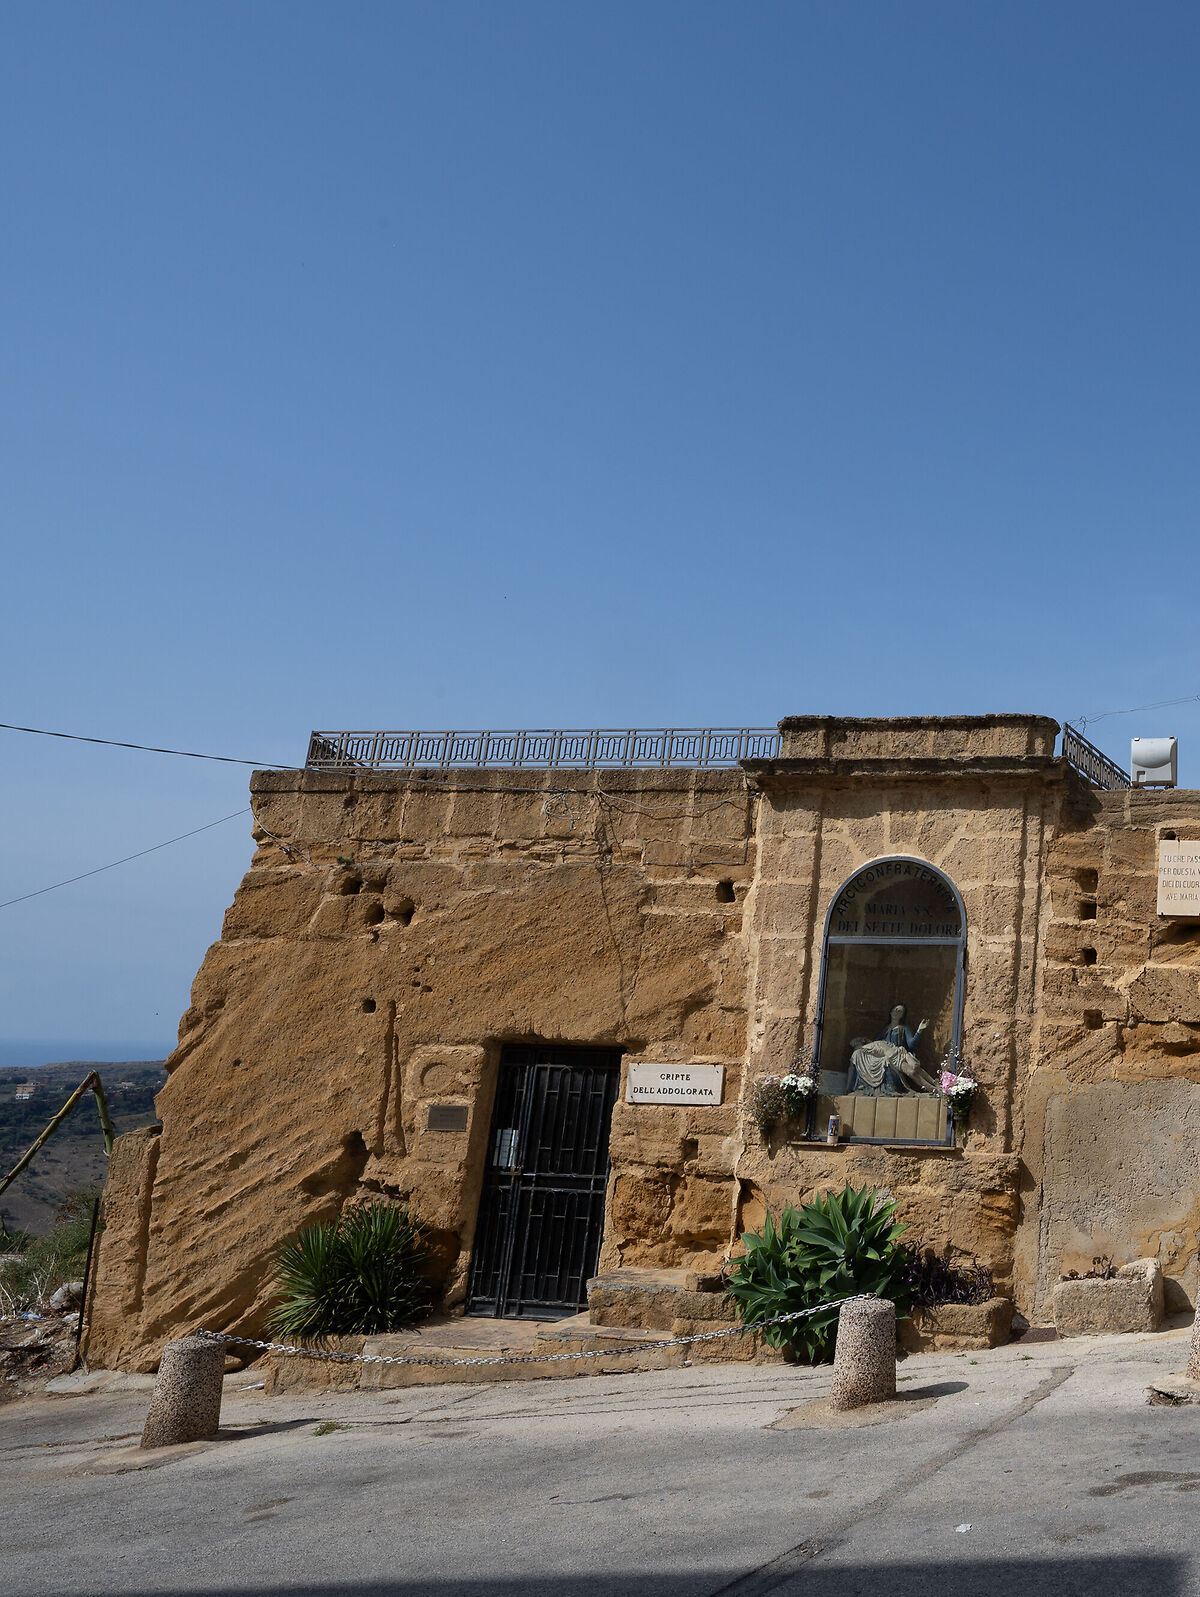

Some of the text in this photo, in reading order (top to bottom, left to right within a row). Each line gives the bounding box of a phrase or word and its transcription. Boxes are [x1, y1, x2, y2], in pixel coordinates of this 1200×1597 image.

[1172, 855, 1185, 863] CHE
[1159, 867, 1171, 875] PER
[1173, 867, 1195, 876] QUESTA
[1179, 893, 1199, 901] MARIA
[865, 904, 905, 916] MARIA
[864, 921, 905, 934] SETTE
[660, 1073, 691, 1081] CRIPTE
